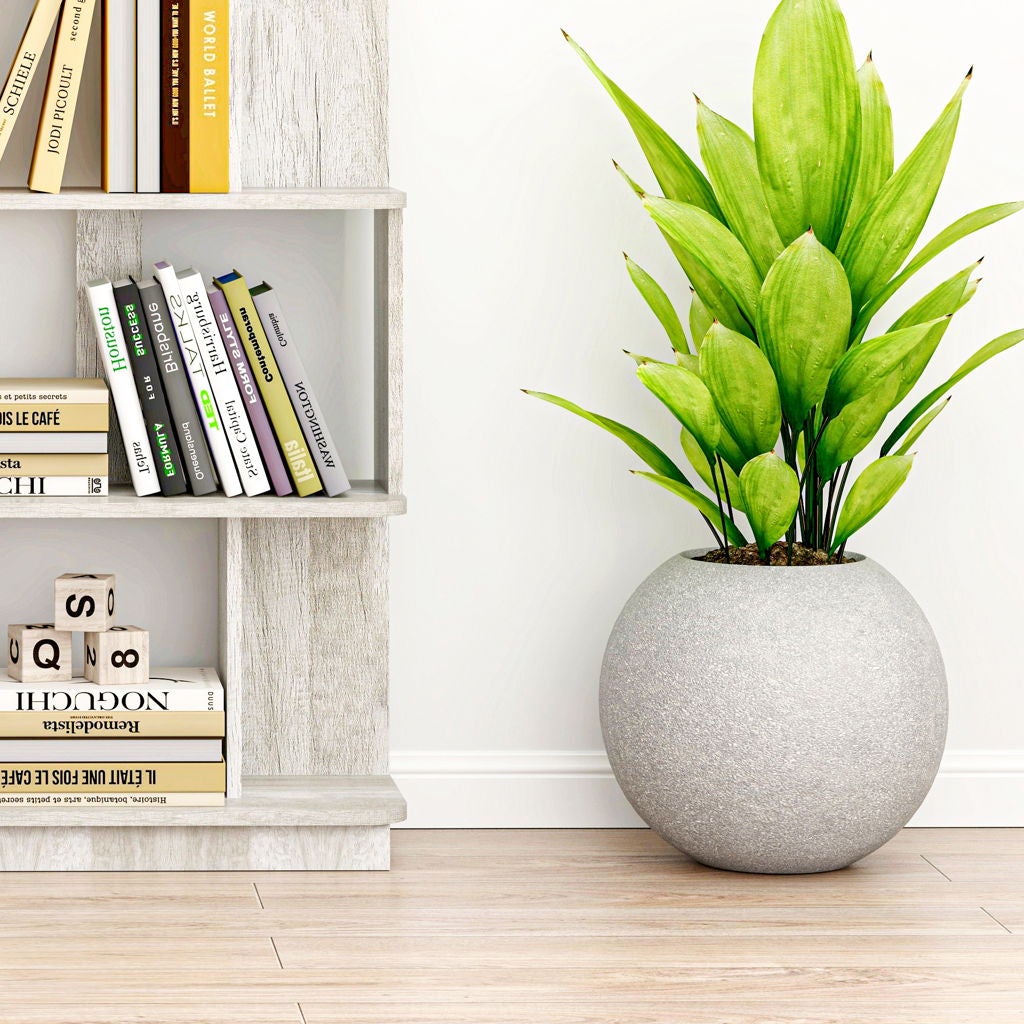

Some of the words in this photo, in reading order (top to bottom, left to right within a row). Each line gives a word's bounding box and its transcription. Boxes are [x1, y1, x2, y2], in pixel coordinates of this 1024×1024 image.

[70, 6, 82, 41] second
[203, 10, 216, 62] WORLD
[3, 51, 37, 116] SCHIELE
[53, 64, 74, 121] PICOULT
[203, 69, 216, 117] BALLET
[47, 124, 62, 154] JODI
[14, 393, 37, 402] petits
[16, 411, 28, 426] LE
[32, 409, 60, 426] CAFÉ
[65, 594, 96, 618] S
[32, 639, 60, 670] Q
[111, 648, 139, 668] 8
[16, 691, 169, 711] NOGUCHI
[43, 720, 140, 734] Remodelista
[0, 769, 32, 788] CAFÉ
[35, 769, 49, 784] LE
[52, 769, 78, 784] FOIS
[82, 769, 105, 784] UNE
[108, 769, 142, 788] ÉTAIT
[146, 769, 156, 784] IL
[26, 795, 51, 805] petits
[53, 796, 62, 804] et
[64, 796, 81, 804] arts
[84, 795, 127, 805] botanique,
[130, 796, 167, 805] Histoire,
